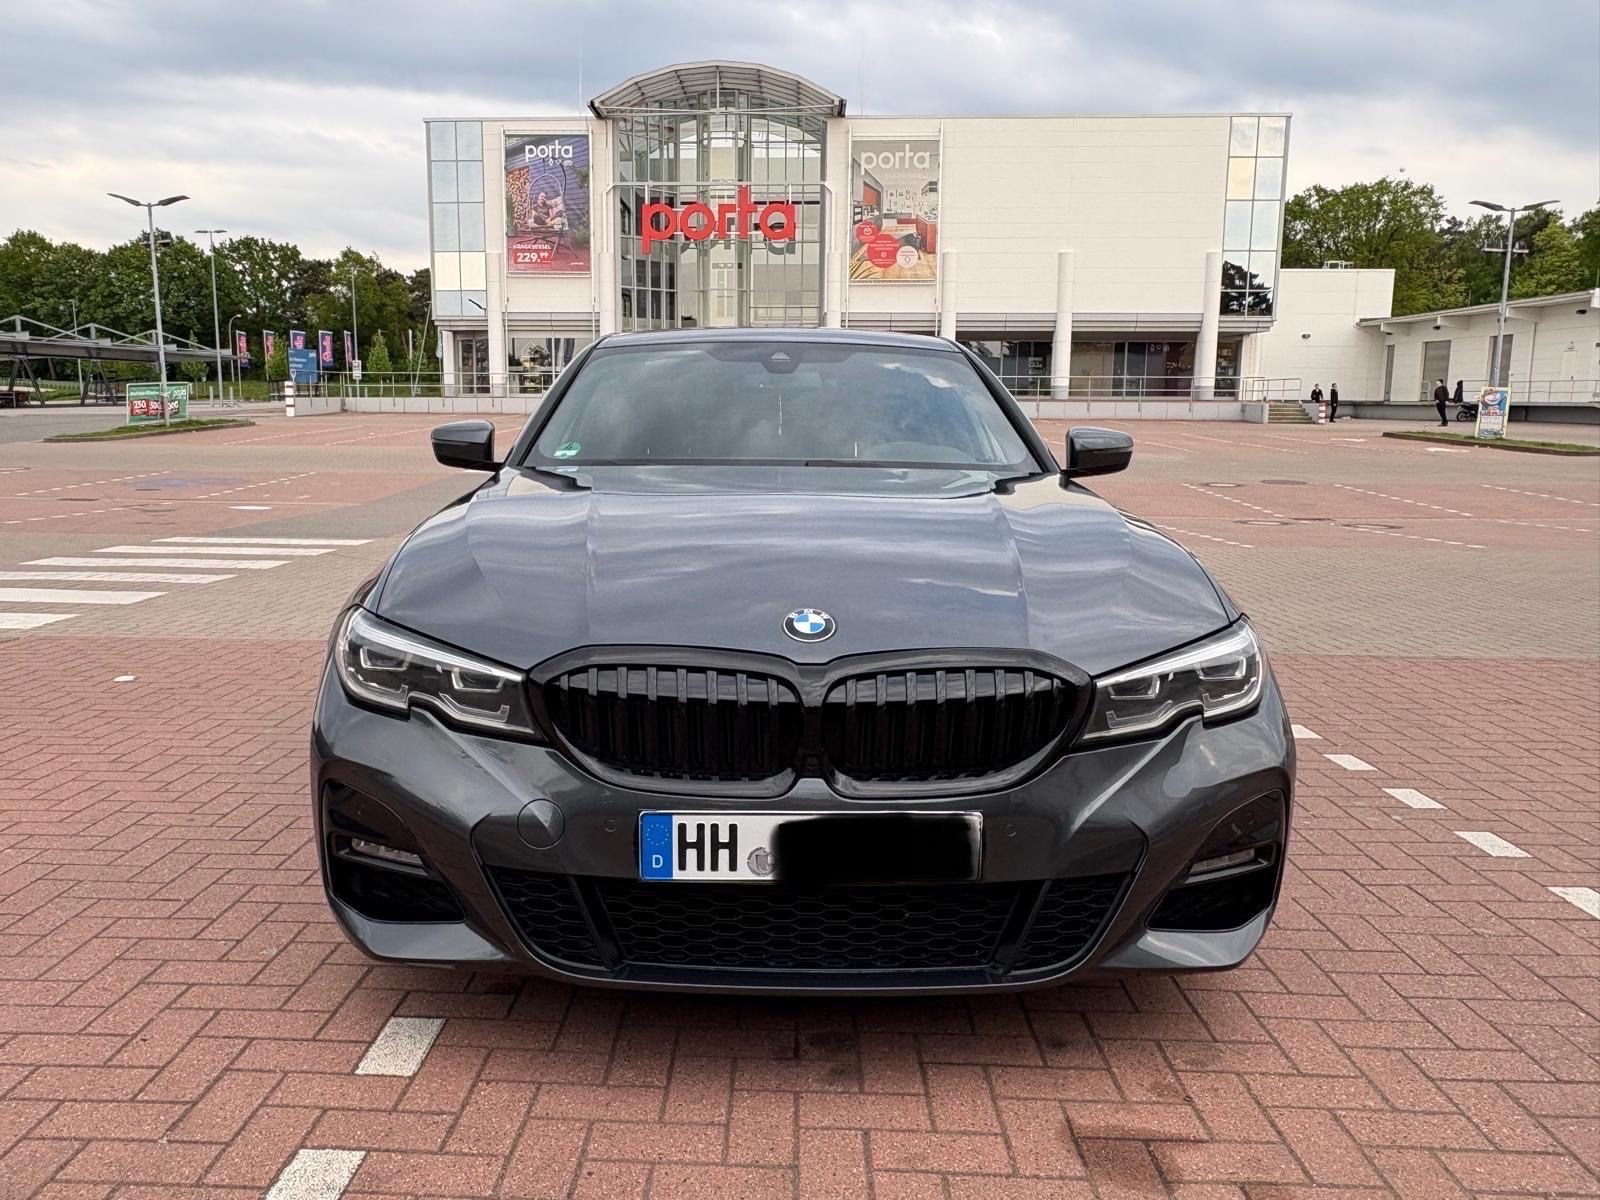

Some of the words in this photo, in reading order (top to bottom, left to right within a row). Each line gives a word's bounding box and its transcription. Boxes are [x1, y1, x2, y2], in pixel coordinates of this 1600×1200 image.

[525, 140, 573, 162] porta
[860, 143, 930, 175] porta
[641, 184, 795, 255] porta
[652, 854, 664, 868] D
[677, 822, 738, 872] HH
